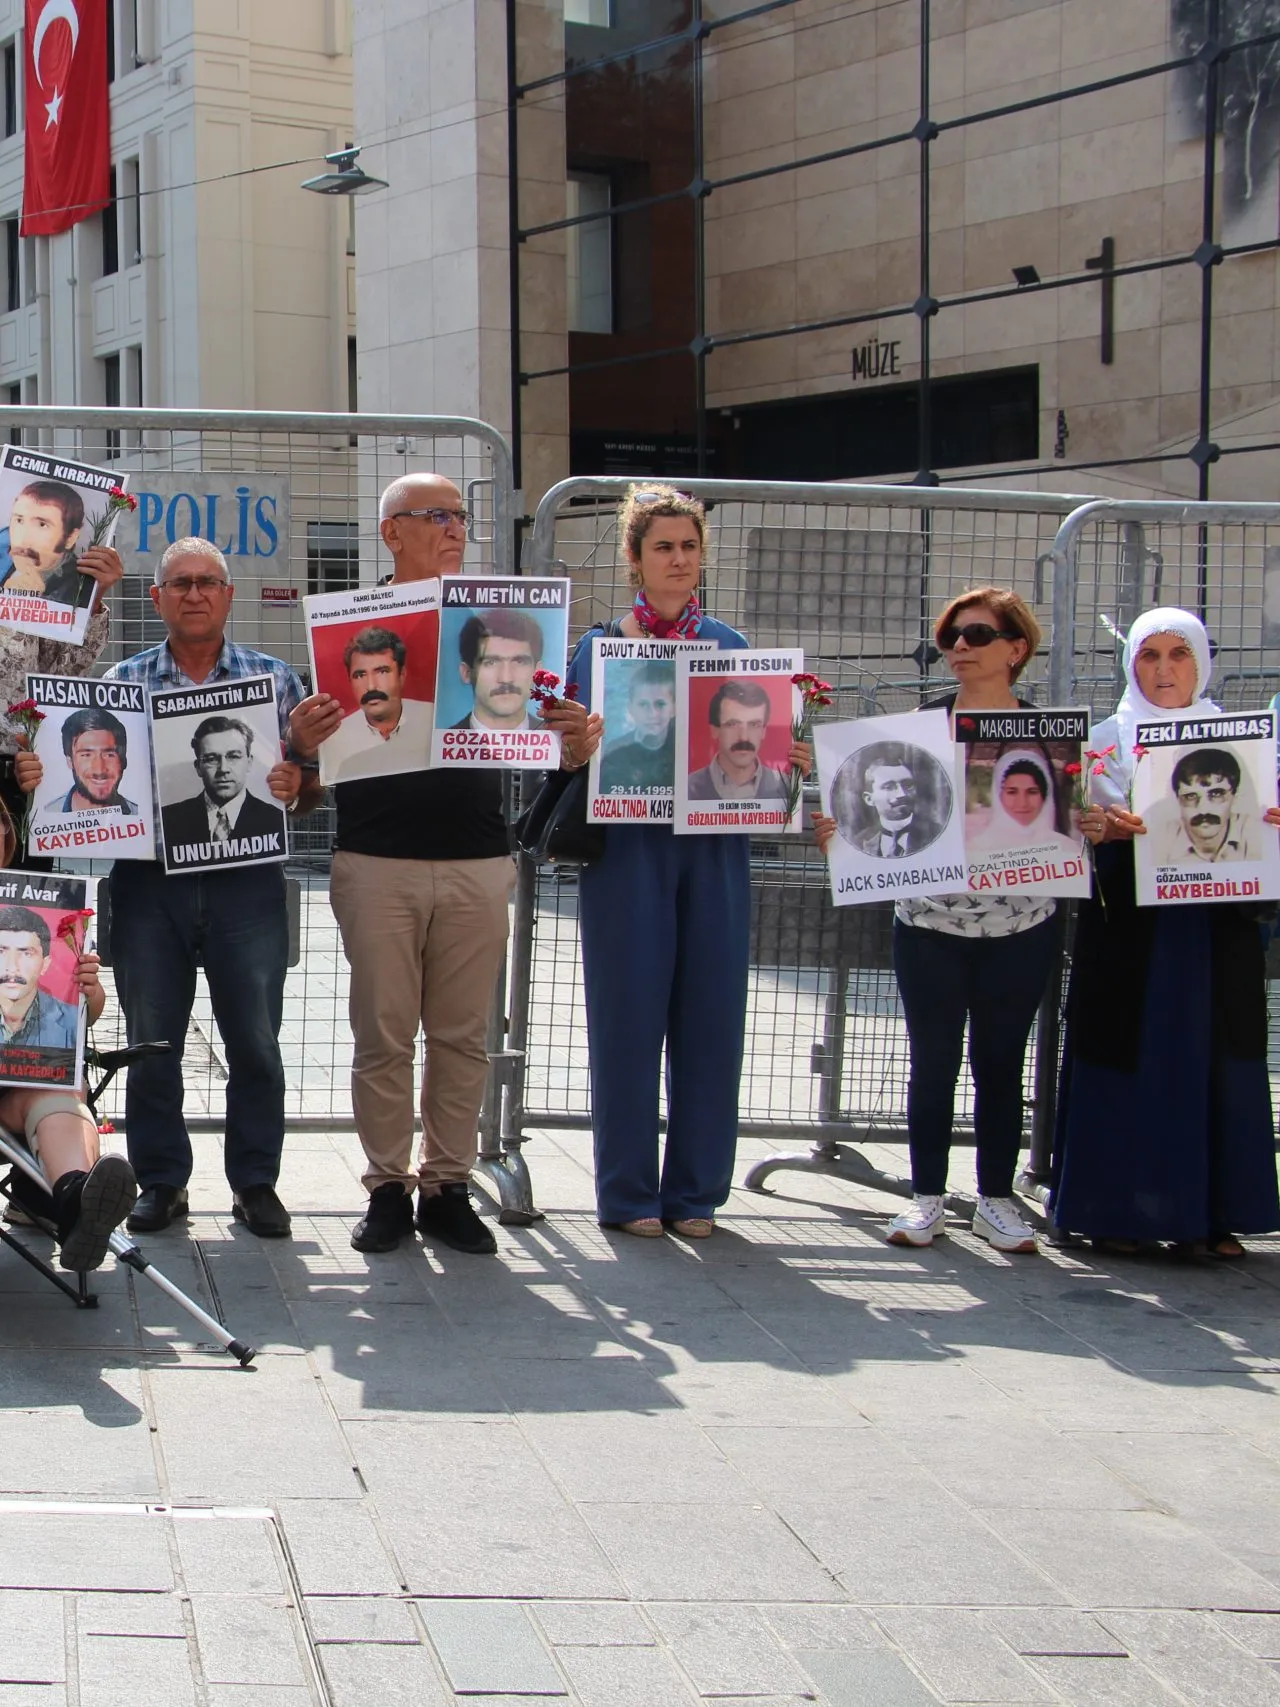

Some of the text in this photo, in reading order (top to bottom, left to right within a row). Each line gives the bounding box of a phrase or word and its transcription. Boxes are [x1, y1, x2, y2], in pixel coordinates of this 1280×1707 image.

[852, 338, 901, 380] MÜZE
[53, 464, 116, 490] KIRBAYIR
[135, 486, 278, 557] POLİS
[447, 583, 562, 605] AV. METİN CAN
[600, 643, 634, 658] DAVUT
[689, 657, 792, 672] FEHMİ TOSUN
[32, 679, 141, 710] HASAN OCAK
[157, 681, 268, 714] SABAHATTİN ALİ
[980, 714, 1084, 738] MAKBULE ÖKDEM
[1139, 718, 1270, 743] ZEKİ ALTUNBAŞ
[442, 730, 551, 746] GÖZALTINDA
[593, 796, 648, 818] GÖZALTINDA
[34, 818, 100, 836] GÖZALTINDA
[688, 812, 740, 826] GÖZALTINDA
[36, 819, 146, 852] KAYBEDİLDİ
[172, 832, 280, 864] UNUTMADIK
[968, 857, 1039, 874] ÖZALTINDA
[838, 864, 964, 893] JACK SAYABALYAN
[1156, 872, 1212, 883] GÖZALTINDA
[1157, 877, 1260, 899] KAYBEDİLDİ
[22, 885, 60, 903] Avar
